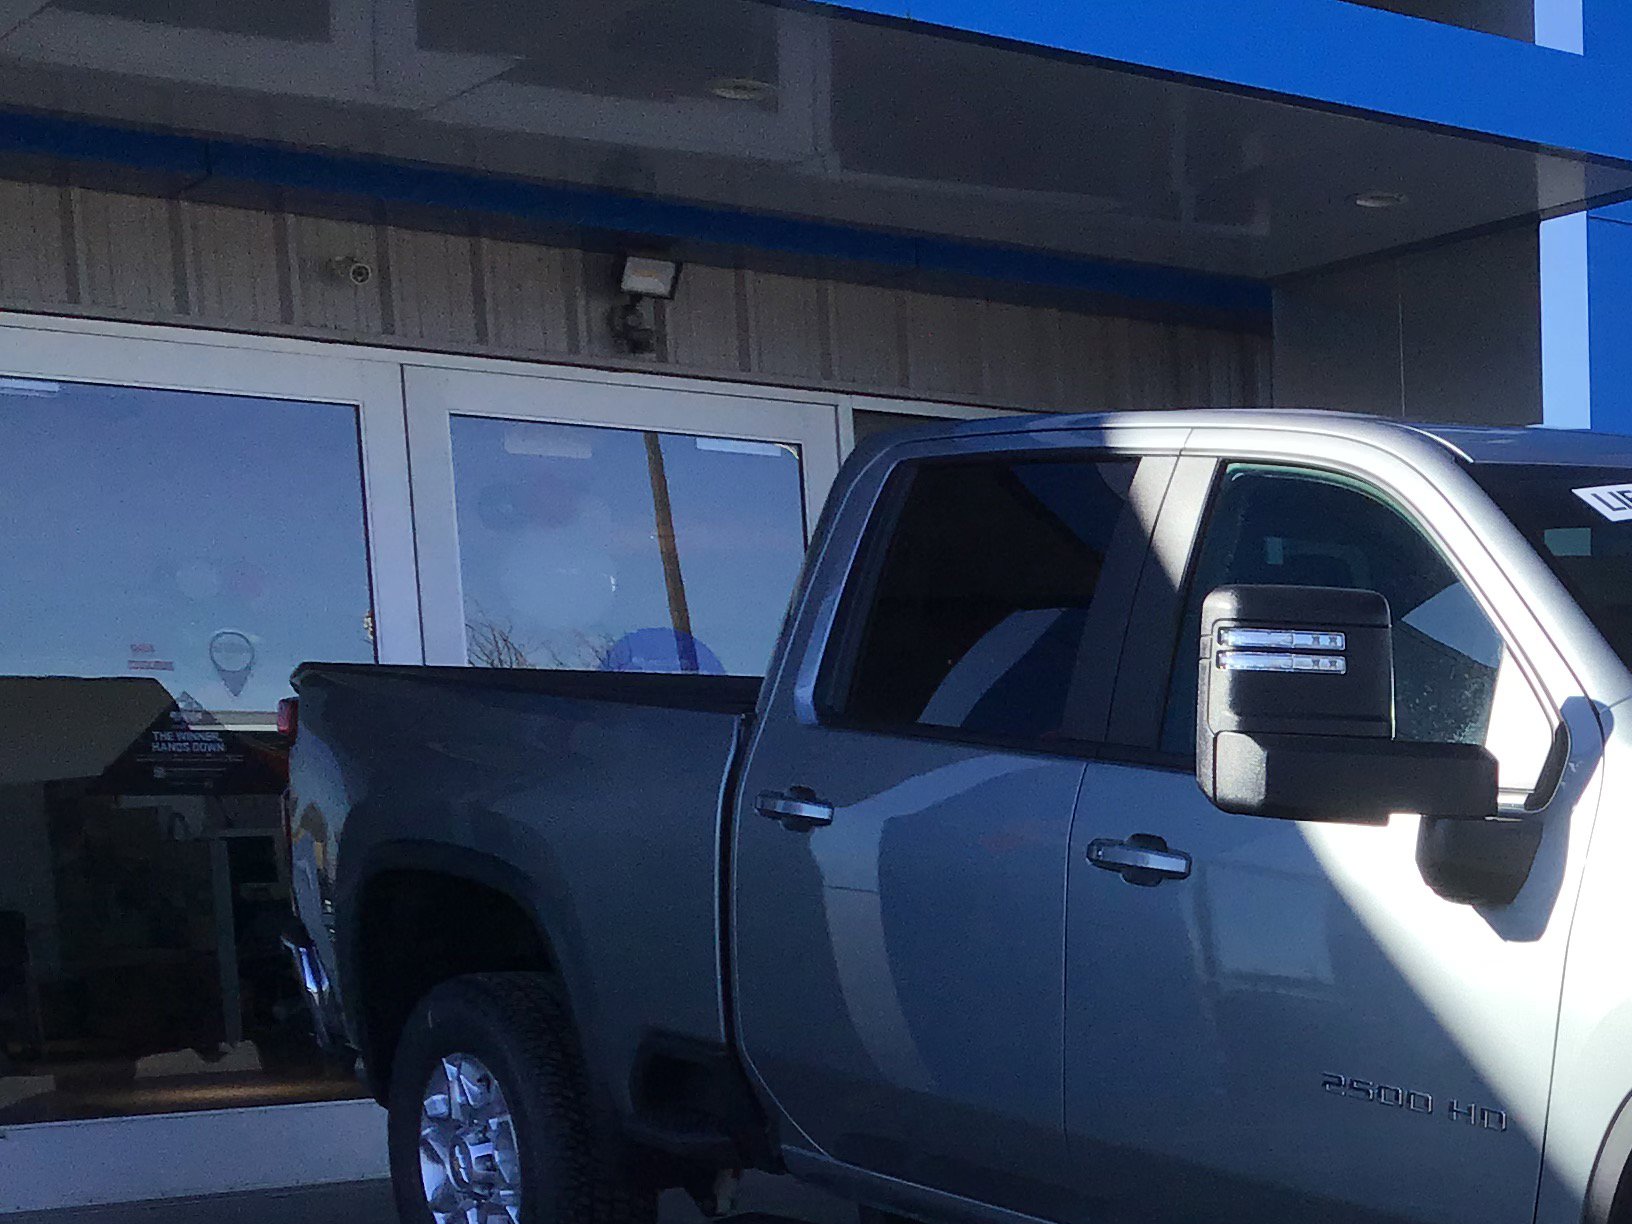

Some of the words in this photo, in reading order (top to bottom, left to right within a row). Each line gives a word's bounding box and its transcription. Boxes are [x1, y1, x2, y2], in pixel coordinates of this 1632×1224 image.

[152, 731, 174, 741] THE
[152, 742, 190, 752] HANDS
[192, 742, 225, 752] DOWN
[1321, 1071, 1433, 1115] 2500
[1449, 1099, 1507, 1132] HD
